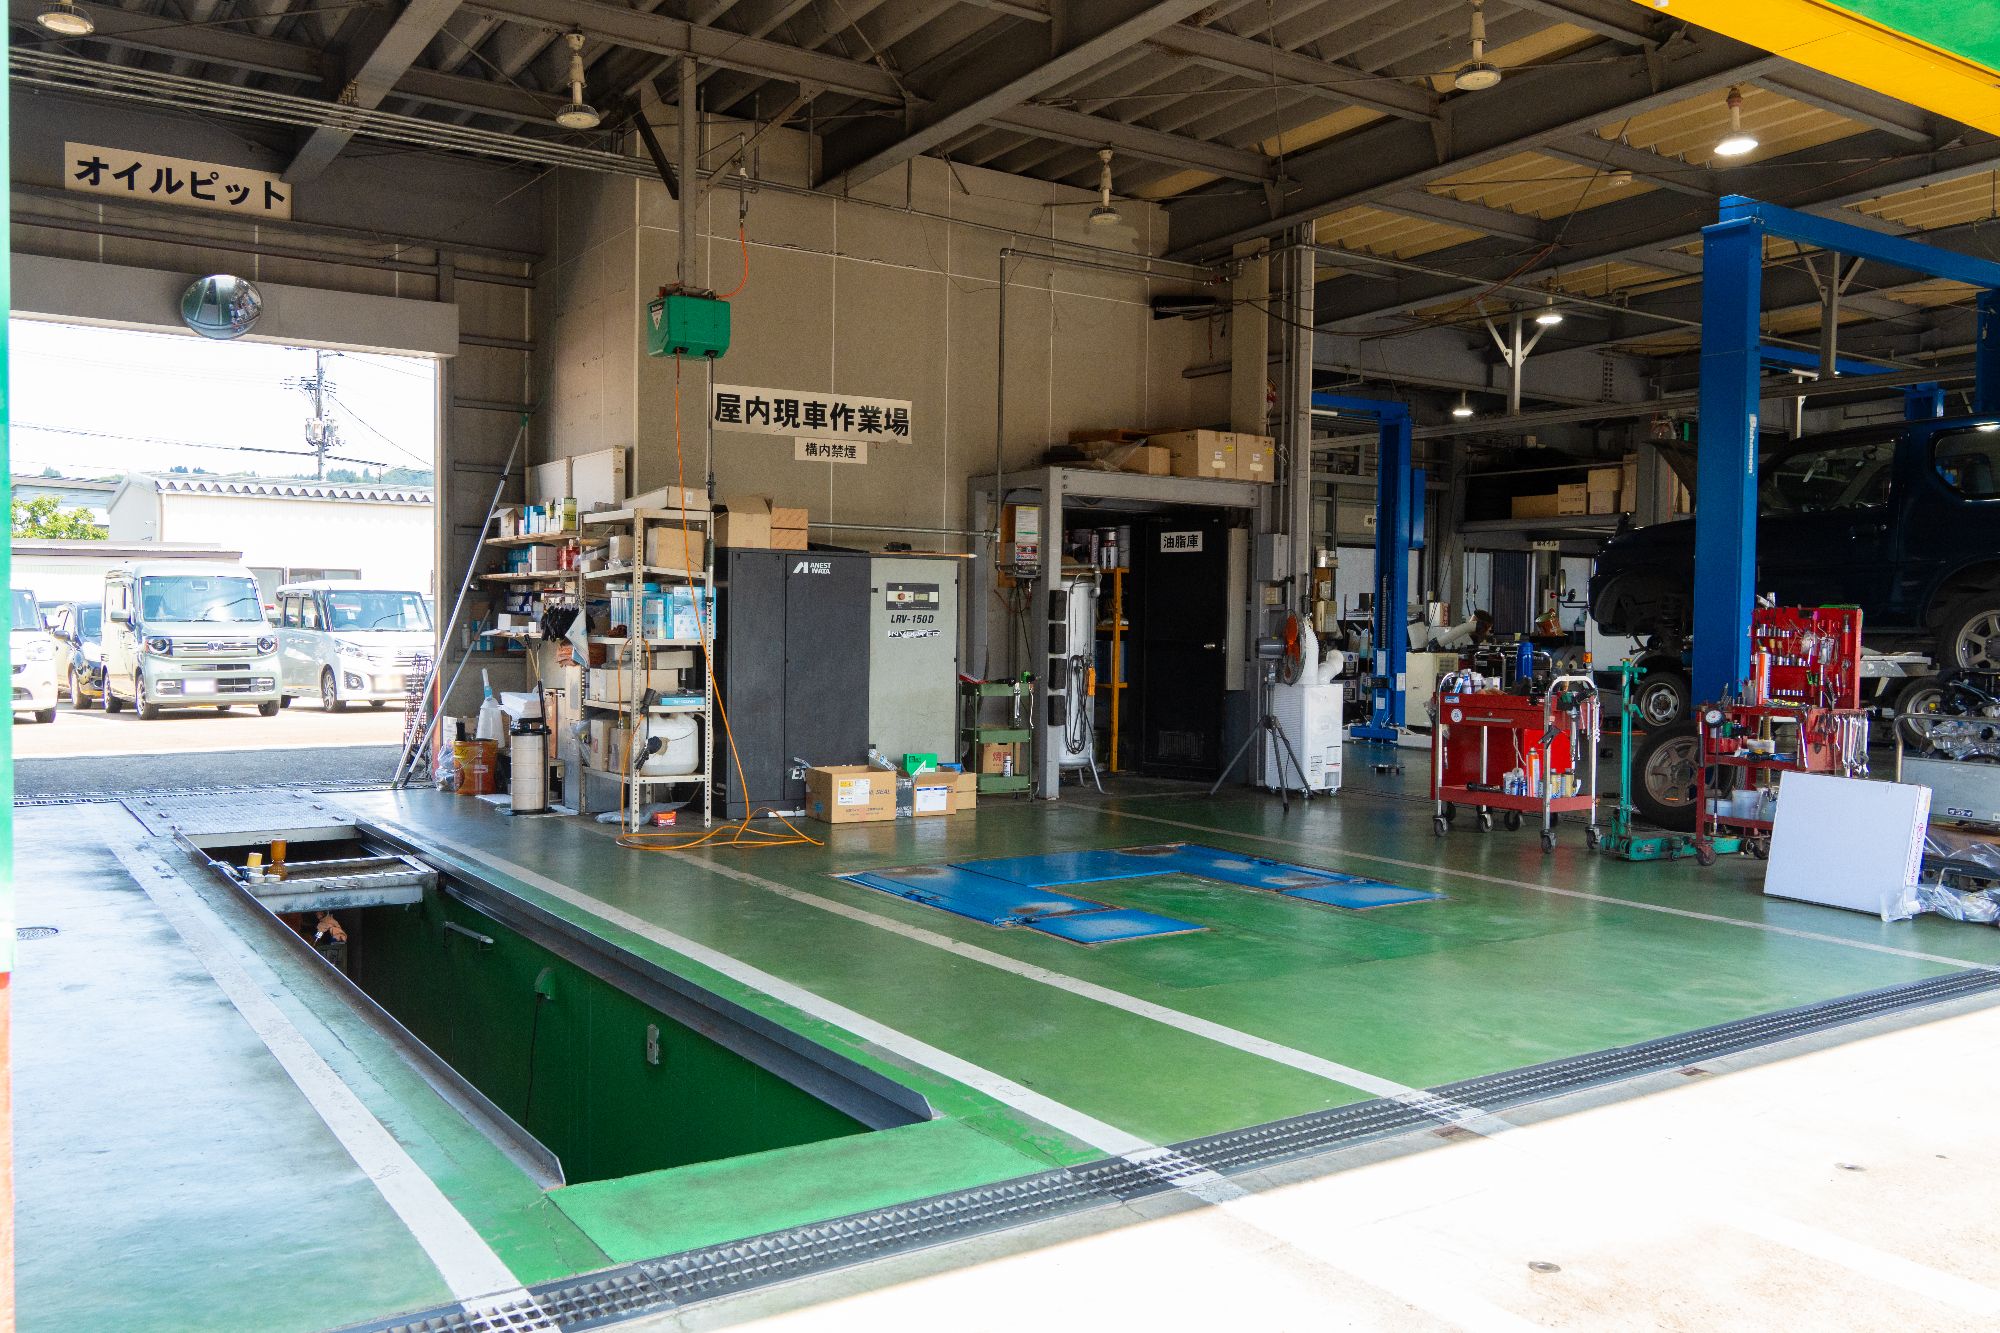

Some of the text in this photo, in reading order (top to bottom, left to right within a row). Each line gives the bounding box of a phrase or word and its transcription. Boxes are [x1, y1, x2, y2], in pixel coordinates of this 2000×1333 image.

[75, 156, 285, 209] オイルピット
[714, 393, 909, 436] 屋内現車作業場
[805, 442, 857, 459] 構内禁煙
[1163, 534, 1199, 550] 油脂庫
[890, 614, 934, 624] LRV-150D
